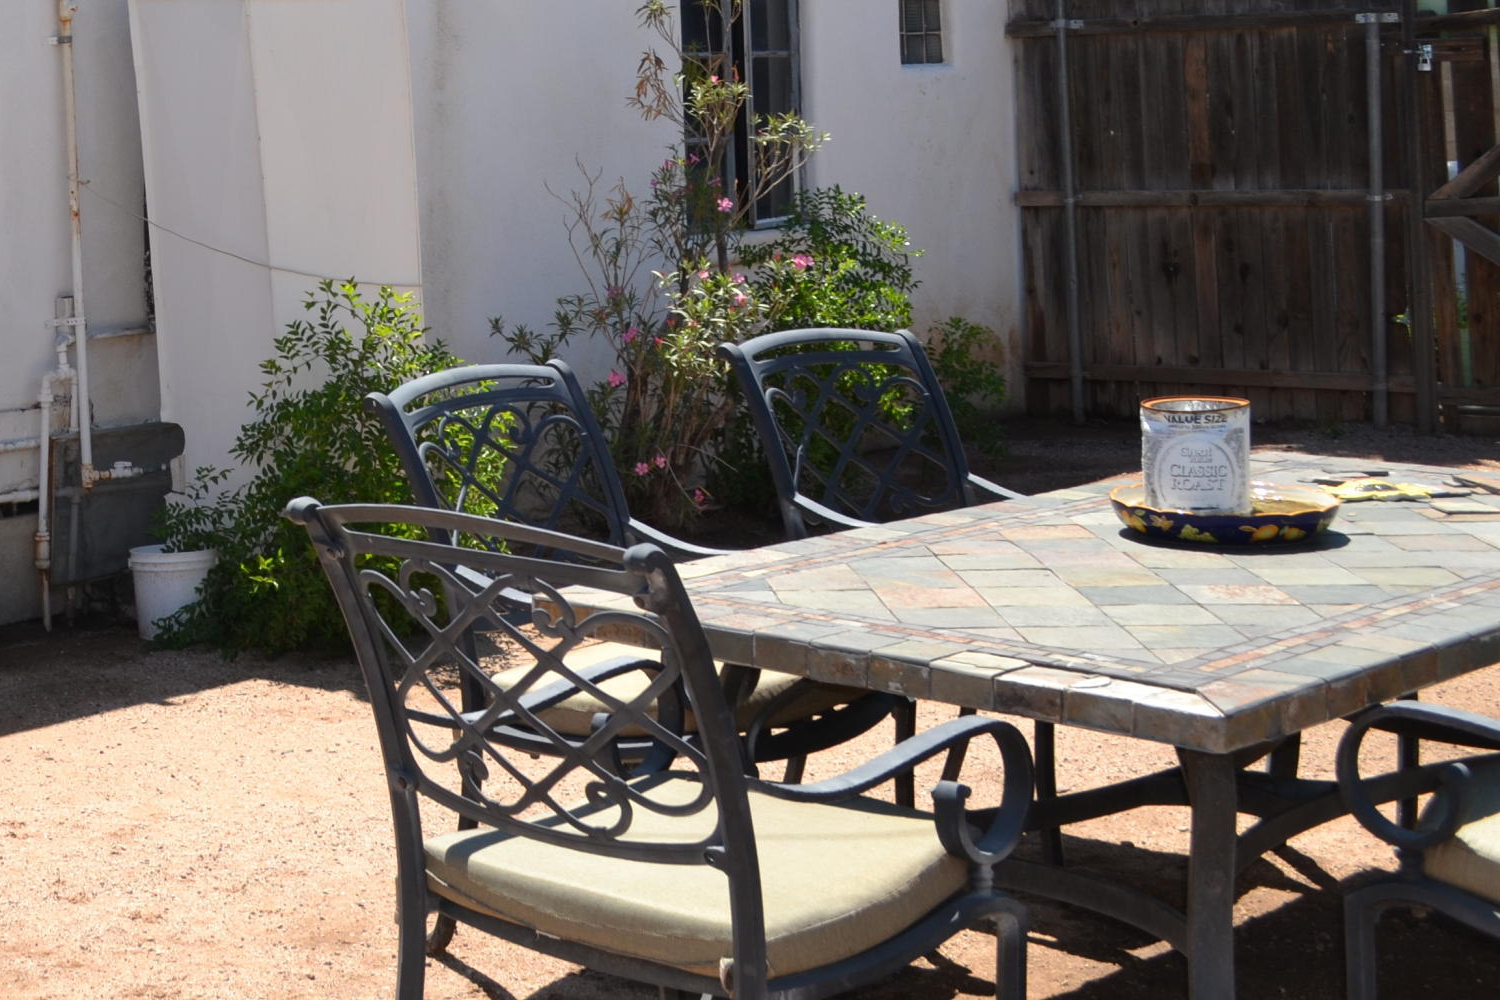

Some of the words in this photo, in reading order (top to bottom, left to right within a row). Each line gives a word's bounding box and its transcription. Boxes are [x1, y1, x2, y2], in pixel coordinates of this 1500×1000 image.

[1164, 414, 1201, 425] VALUE
[1203, 413, 1228, 424] SIZE
[1170, 464, 1228, 478] CLASSIC
[1171, 478, 1225, 491] ROAST
